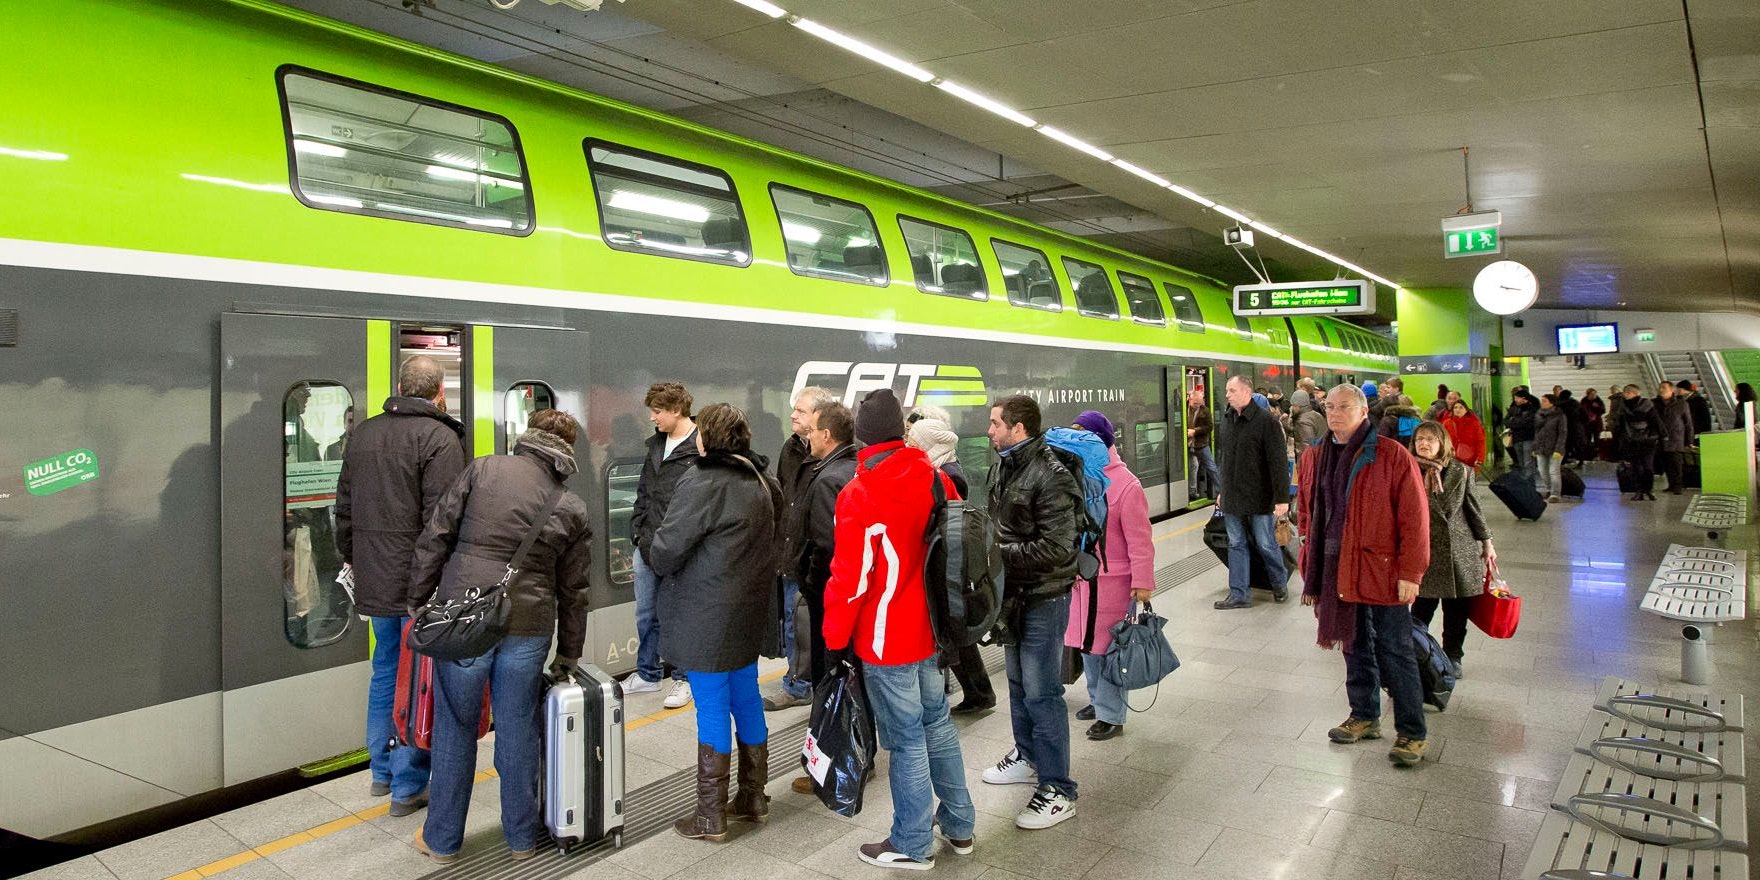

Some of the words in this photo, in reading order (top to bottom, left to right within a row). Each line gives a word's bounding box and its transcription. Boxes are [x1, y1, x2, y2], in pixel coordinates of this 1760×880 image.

[1249, 292, 1260, 307] 5
[790, 361, 937, 408] CAT
[1048, 389, 1093, 404] AIRPORT
[1097, 388, 1125, 402] TRAIN
[27, 460, 64, 480] NULL
